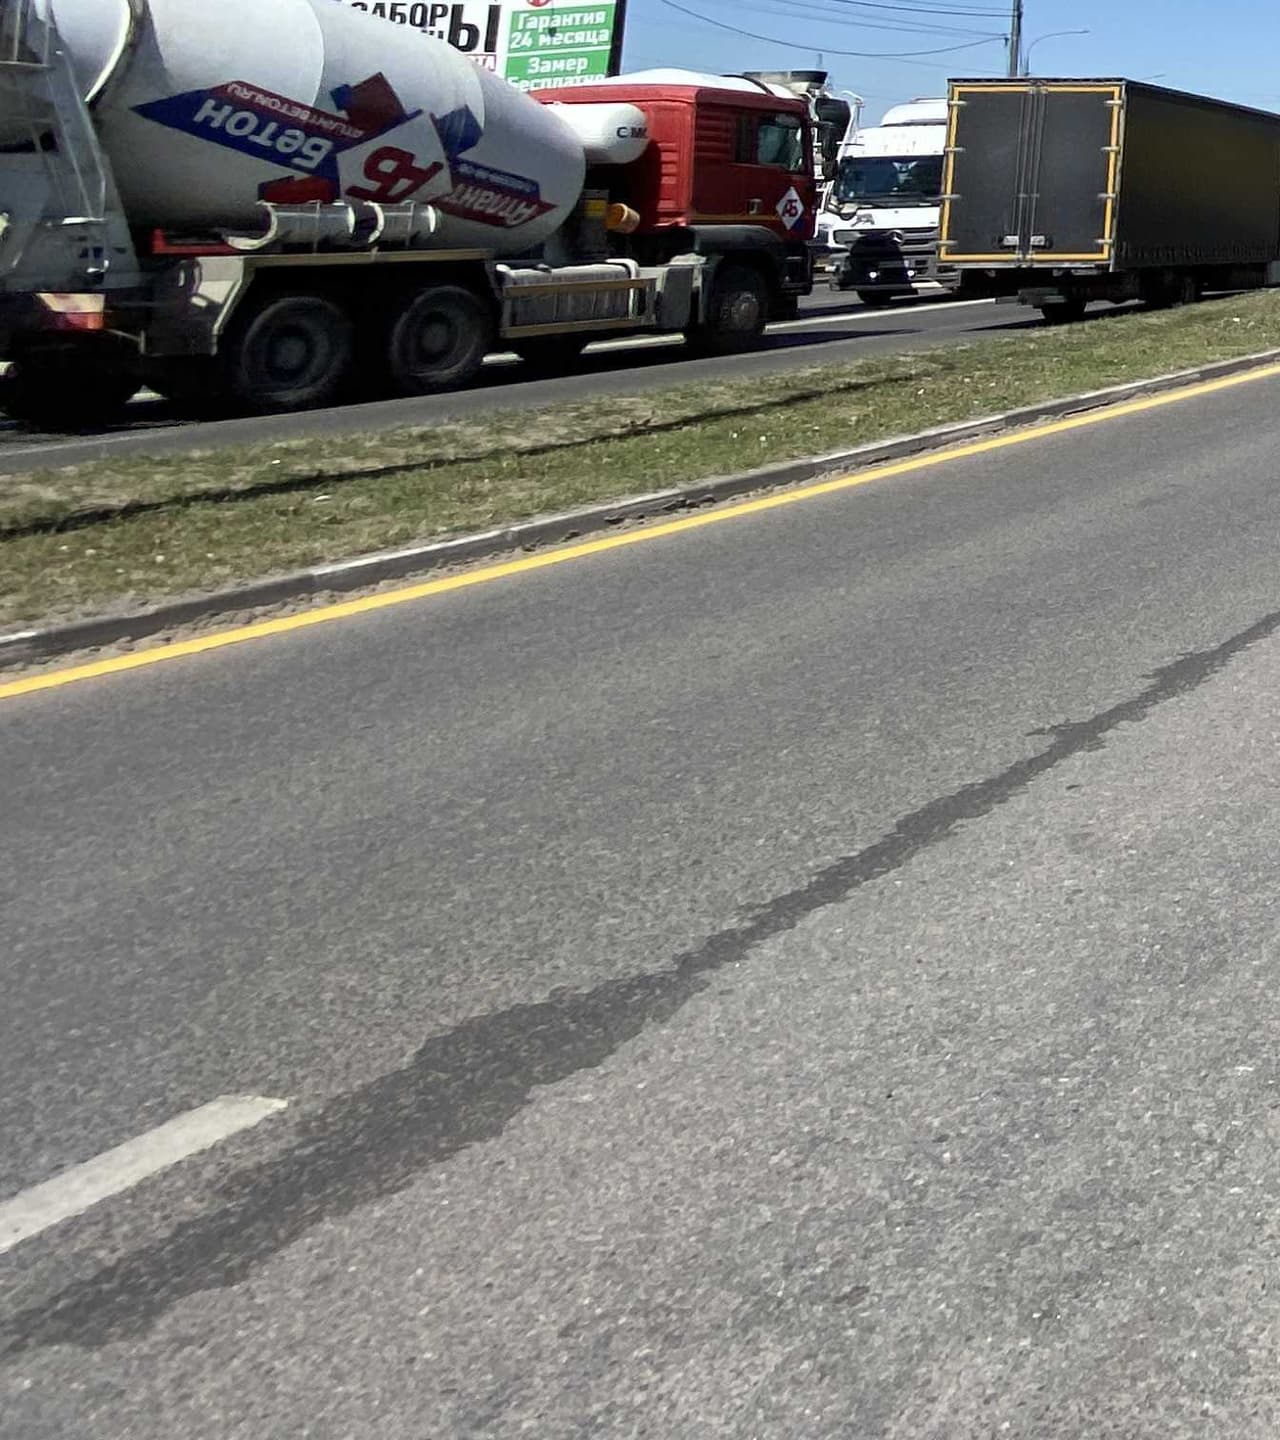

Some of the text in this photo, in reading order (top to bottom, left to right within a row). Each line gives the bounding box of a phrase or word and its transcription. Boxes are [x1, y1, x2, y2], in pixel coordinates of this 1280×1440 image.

[517, 10, 607, 33] Гарантия
[510, 28, 610, 49] 24 месяца
[527, 56, 589, 75] Замер
